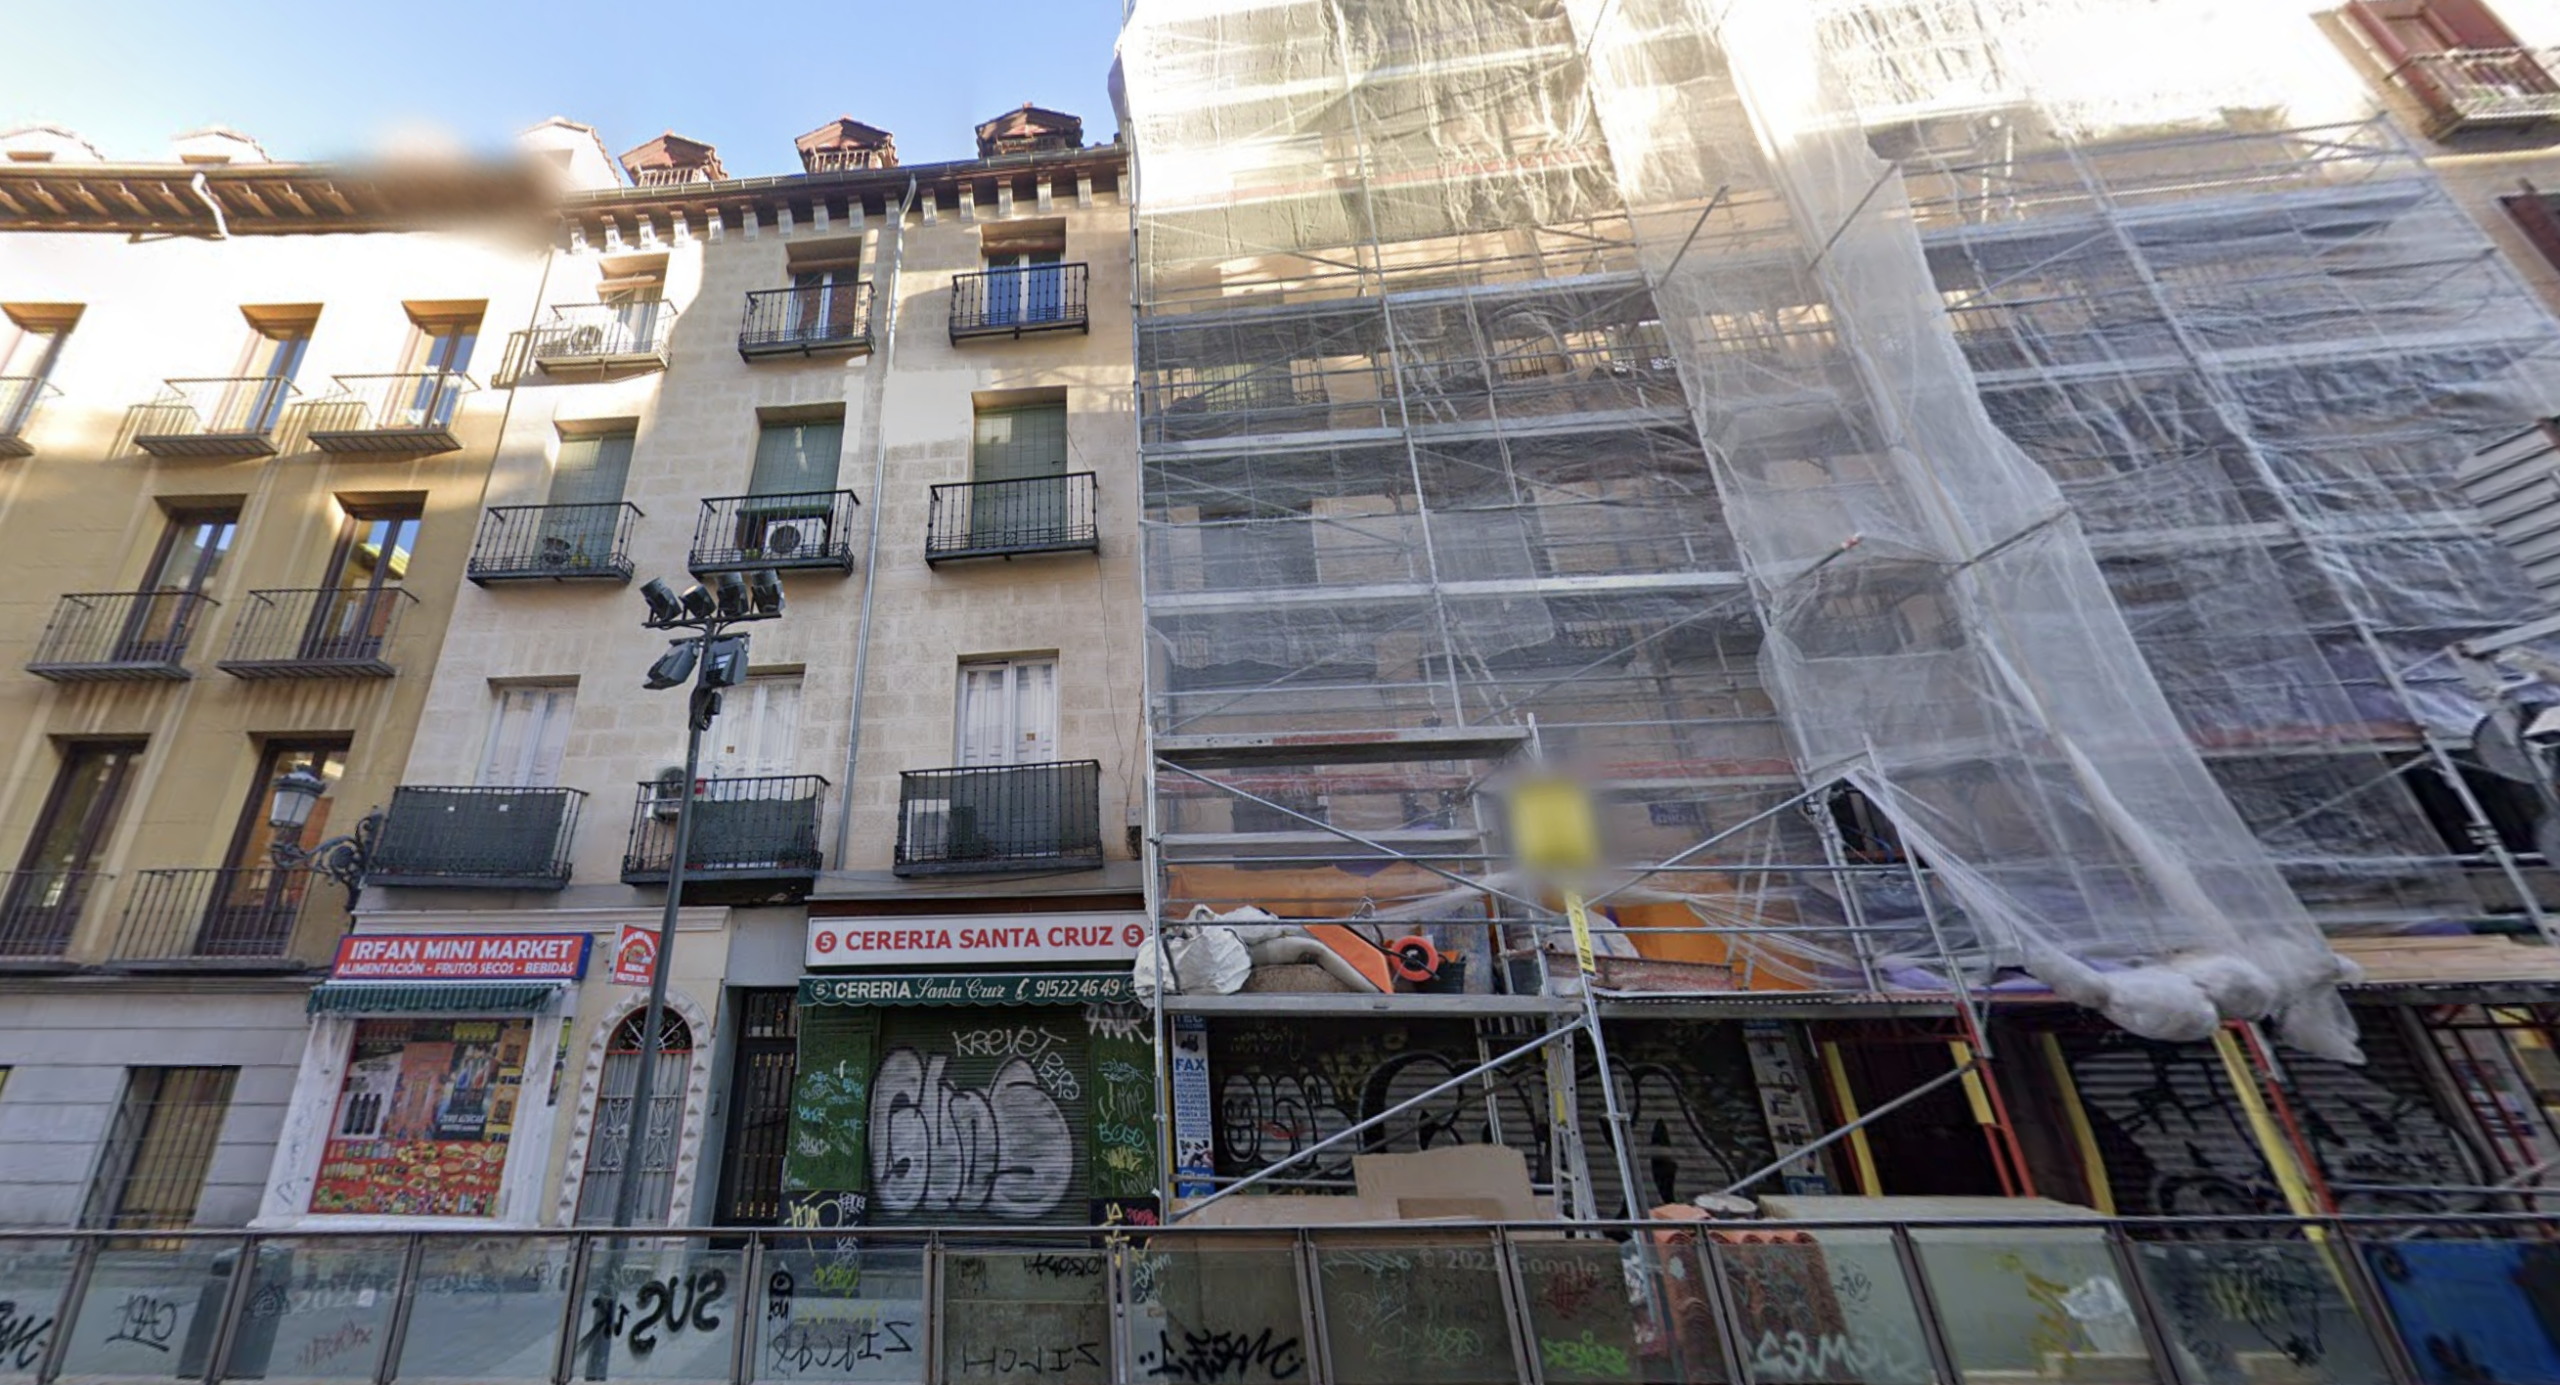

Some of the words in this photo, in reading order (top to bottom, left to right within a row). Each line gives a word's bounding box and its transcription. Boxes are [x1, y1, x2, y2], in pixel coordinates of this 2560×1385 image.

[845, 930, 952, 951] CERERIA
[959, 927, 1041, 949] SANTA
[1047, 926, 1114, 947] CRUZ
[350, 941, 418, 960] IRFAN
[423, 941, 473, 960] MINI
[479, 940, 573, 960] MARKET
[337, 961, 424, 974] ALIMENTACIÓN
[434, 962, 478, 974] FRUTOS
[479, 962, 514, 974] SECOS
[524, 961, 574, 974] BEBIDAS
[835, 980, 911, 999] CERERIA
[915, 977, 961, 999] Santa
[966, 977, 1006, 999] Cruz
[776, 1010, 784, 1022] 5
[1176, 1058, 1206, 1070] FAX
